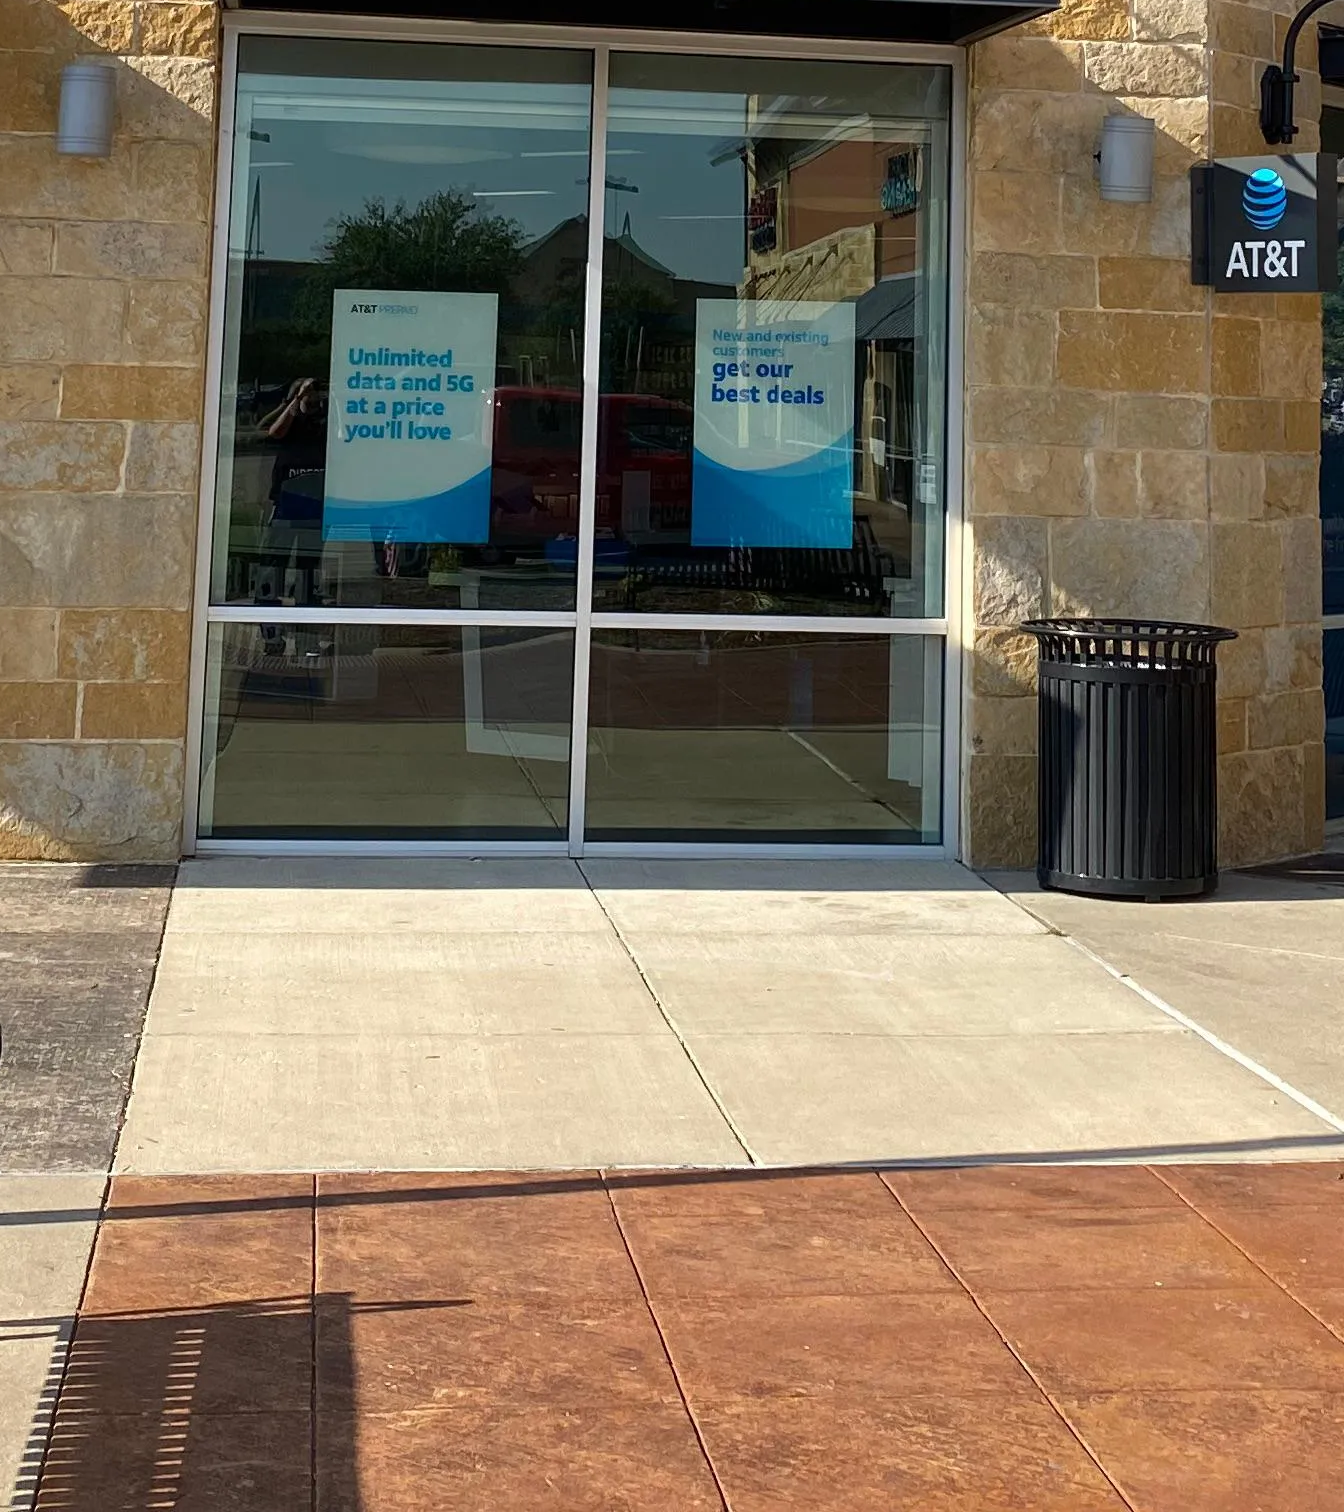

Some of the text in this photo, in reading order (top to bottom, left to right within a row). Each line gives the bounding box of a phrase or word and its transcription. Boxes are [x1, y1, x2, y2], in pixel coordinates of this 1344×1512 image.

[1225, 240, 1305, 278] AT&T
[350, 304, 377, 314] AT&T
[713, 329, 829, 346] New and existing
[349, 347, 453, 368] Unlimited
[713, 346, 784, 357] cusmers
[347, 371, 474, 392] data and 5G
[712, 360, 794, 382] get our
[711, 383, 824, 404] best deals
[346, 396, 445, 419] at a price
[344, 420, 452, 443] you'll love
